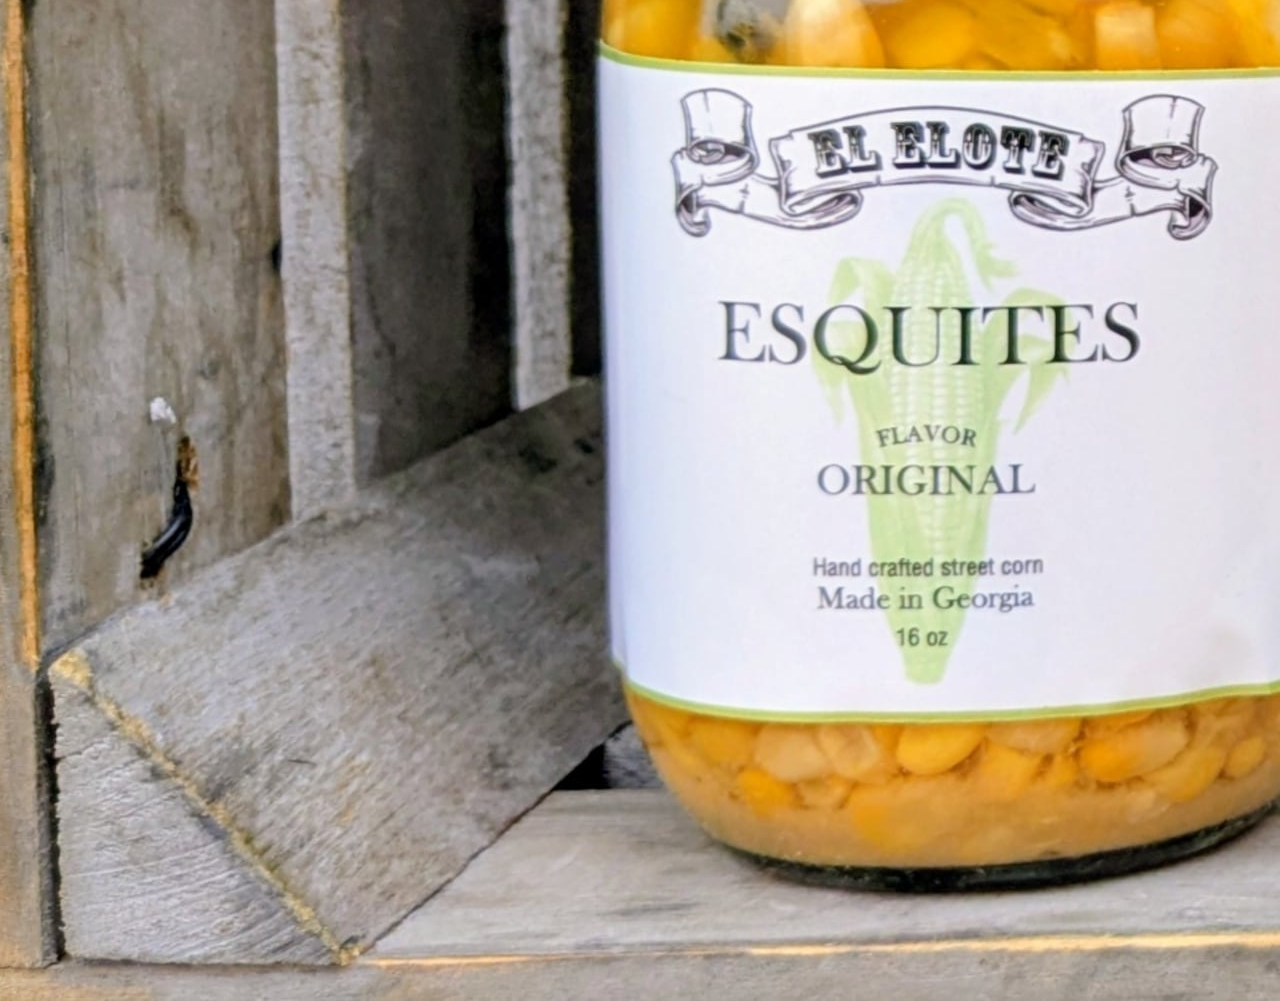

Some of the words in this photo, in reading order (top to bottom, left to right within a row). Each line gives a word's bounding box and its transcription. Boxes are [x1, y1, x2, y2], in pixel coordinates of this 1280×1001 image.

[807, 125, 882, 178] EL
[889, 118, 1070, 181] ELOTE
[717, 300, 1142, 375] ESQUITES
[873, 422, 979, 448] FLAVOR
[815, 461, 1037, 497] ORIGINAL
[811, 556, 862, 578] Hand
[867, 556, 934, 579] crafted
[940, 556, 997, 578] street
[1000, 556, 1045, 578] corn
[816, 584, 891, 611] Made
[898, 584, 925, 610] in
[931, 583, 1036, 613] Georgia
[896, 628, 921, 648] 16
[925, 630, 949, 648] oz
